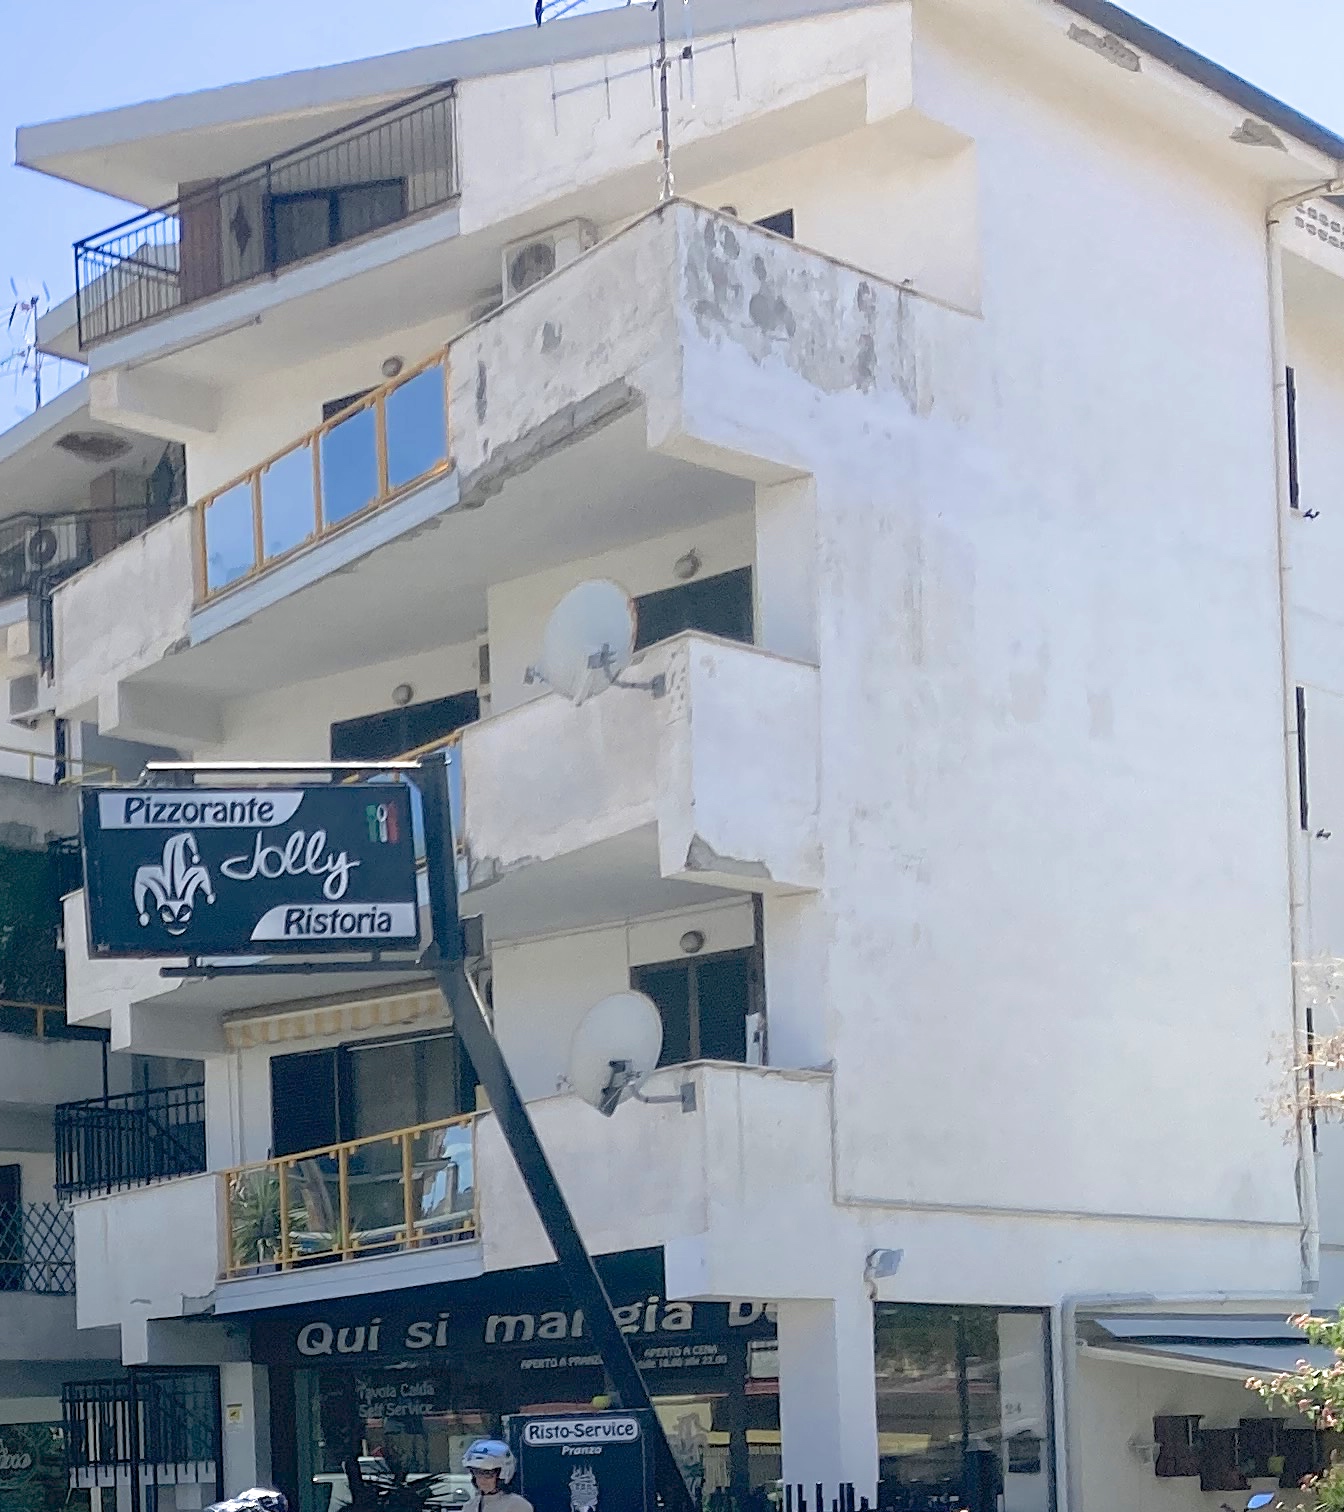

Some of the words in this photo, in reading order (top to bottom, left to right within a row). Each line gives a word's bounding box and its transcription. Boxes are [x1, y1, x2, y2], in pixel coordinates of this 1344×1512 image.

[123, 796, 275, 825] Pizzorante
[220, 830, 360, 900] Jolly
[284, 905, 392, 936] Ristoria
[296, 1317, 382, 1356] Qui
[404, 1312, 451, 1349] si
[358, 1382, 397, 1400] Tavola
[529, 1422, 634, 1440] Risto-Service
[561, 1445, 603, 1456] Pranzo
